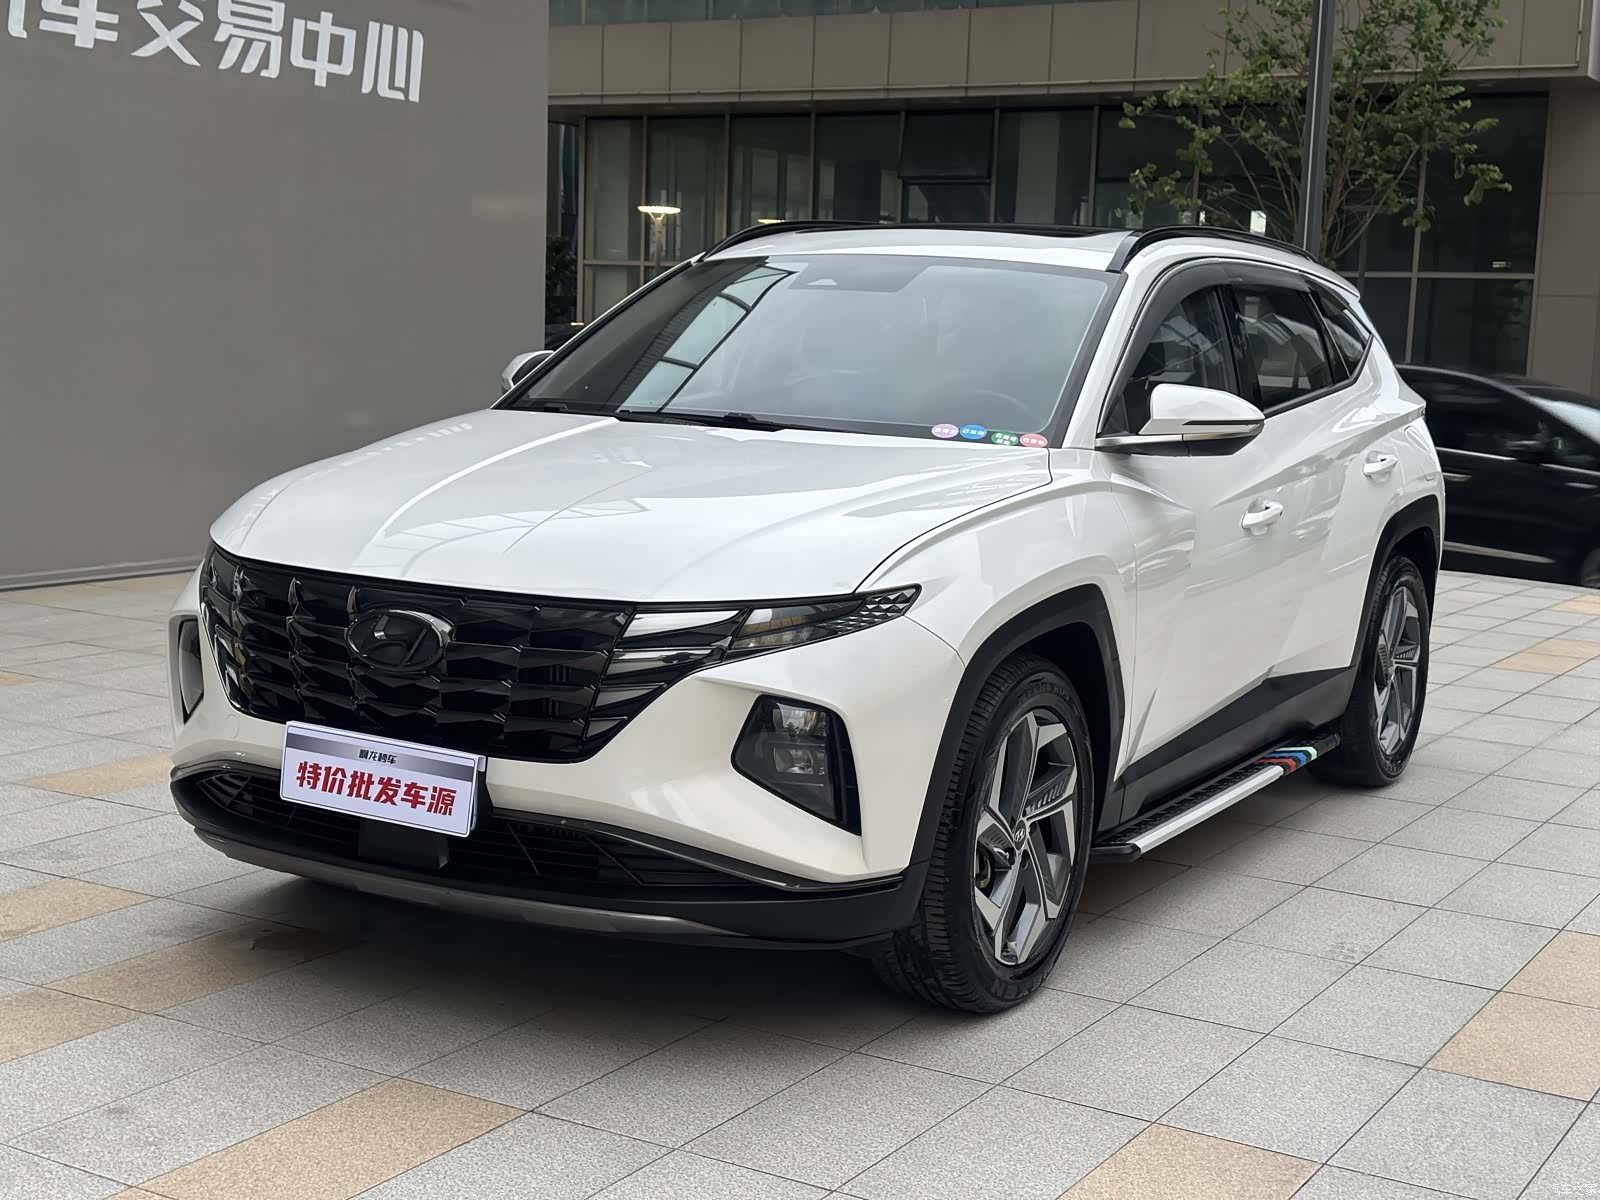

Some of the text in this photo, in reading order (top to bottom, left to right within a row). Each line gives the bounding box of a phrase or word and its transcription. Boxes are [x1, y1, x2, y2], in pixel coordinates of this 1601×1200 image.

[8, 0, 424, 103] 车交易中心
[296, 761, 457, 817] 特价批发车源
